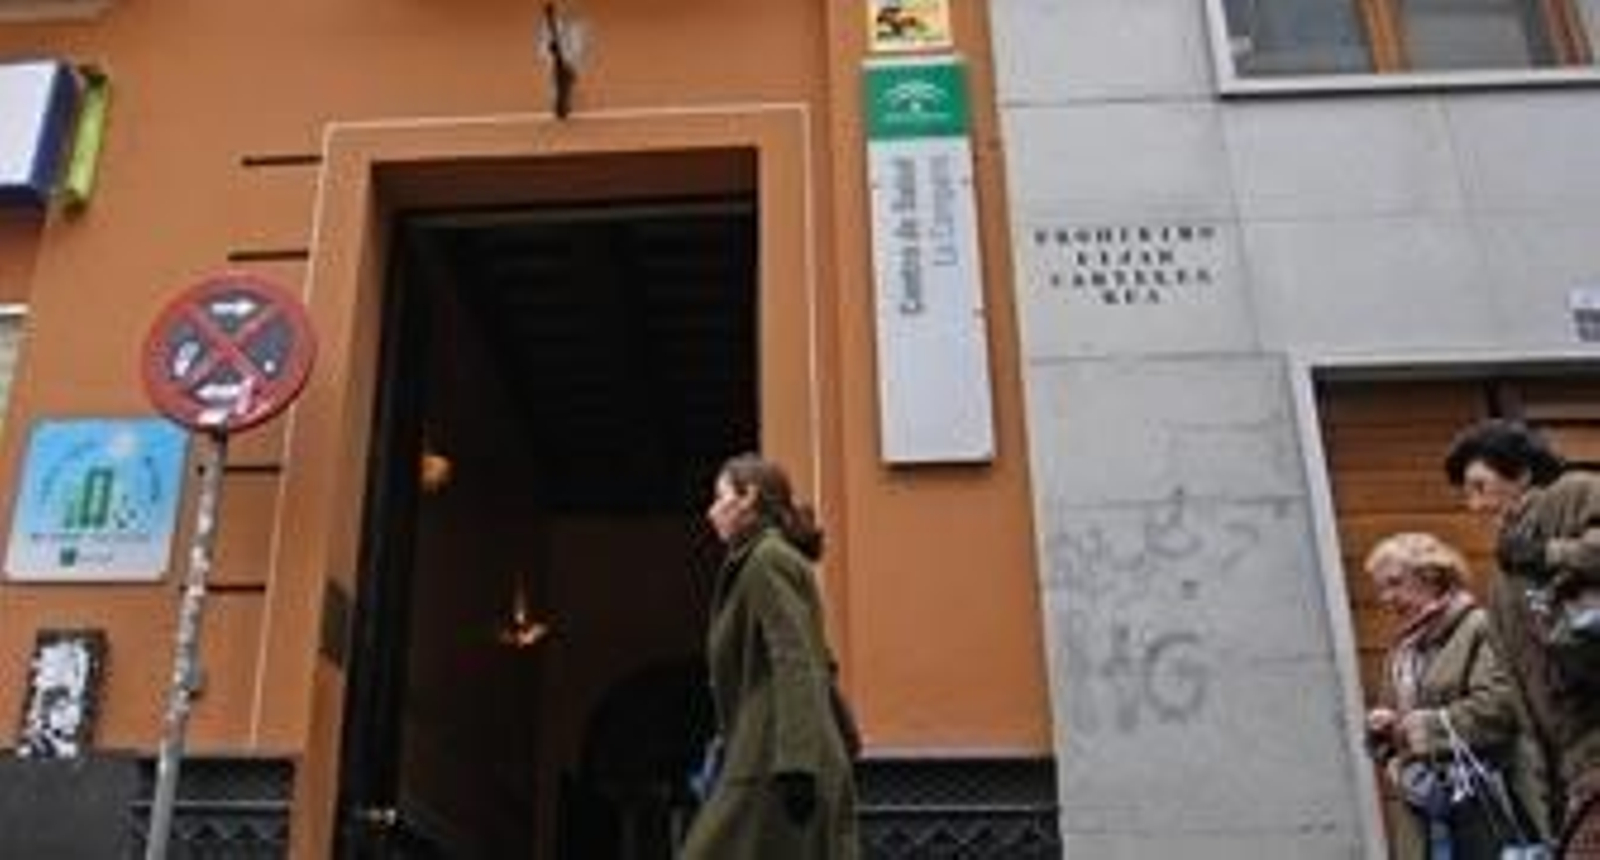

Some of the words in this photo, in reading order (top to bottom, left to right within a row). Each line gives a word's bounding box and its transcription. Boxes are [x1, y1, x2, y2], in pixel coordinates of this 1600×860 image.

[891, 157, 916, 212] Salud
[893, 217, 920, 238] de
[899, 244, 924, 314] Centro
